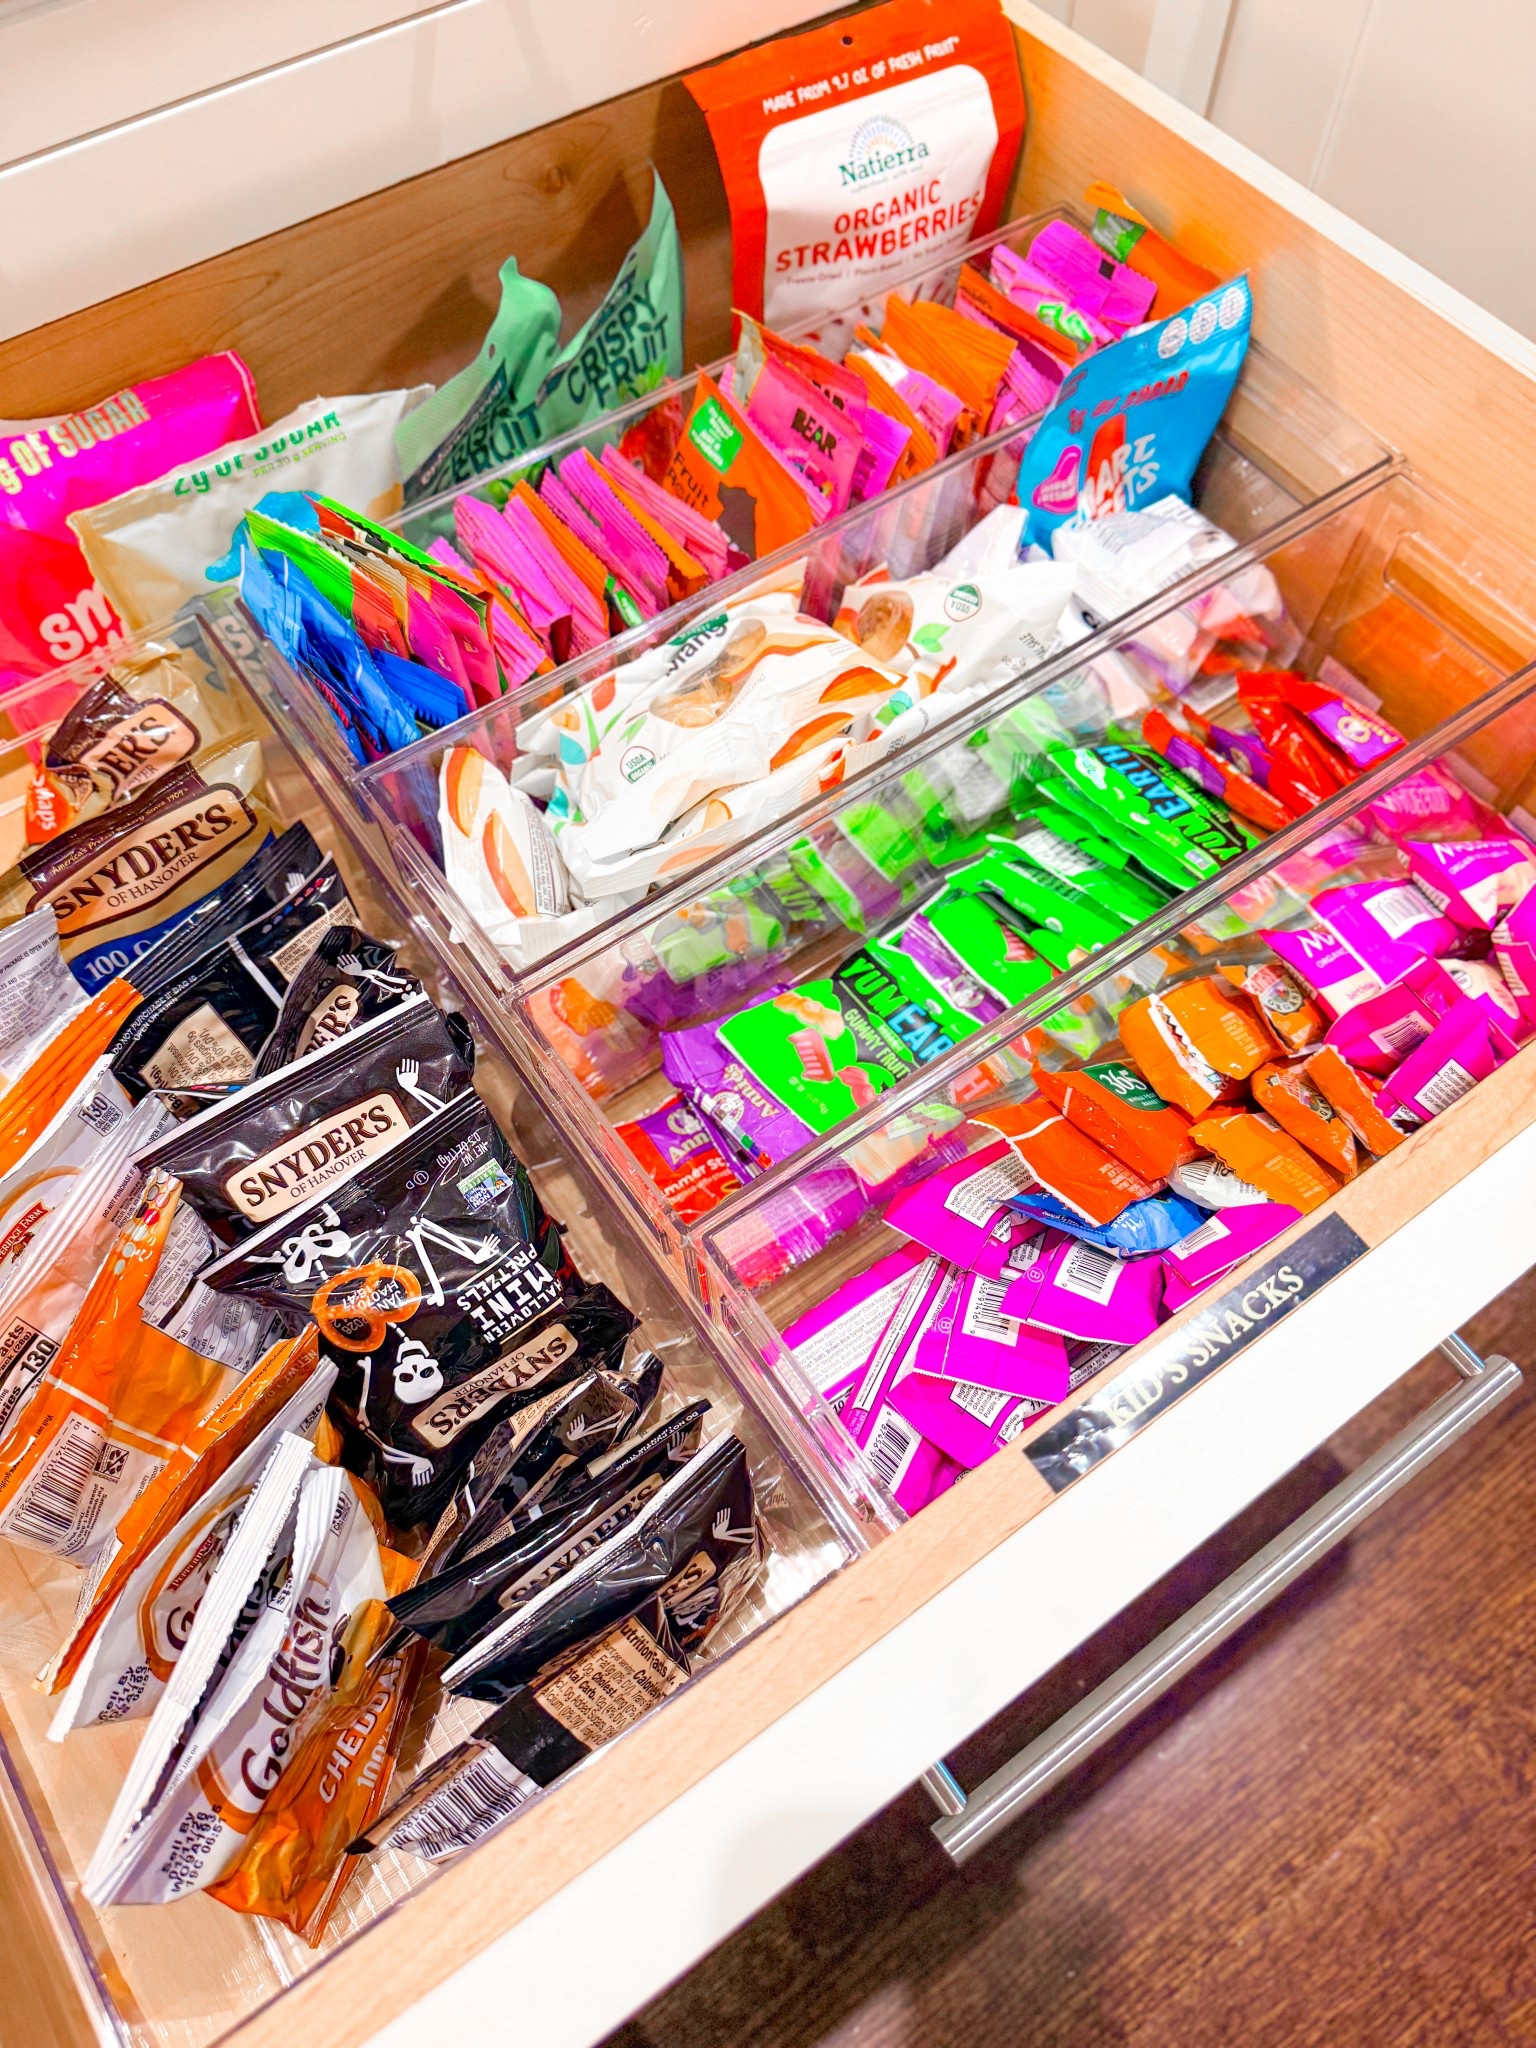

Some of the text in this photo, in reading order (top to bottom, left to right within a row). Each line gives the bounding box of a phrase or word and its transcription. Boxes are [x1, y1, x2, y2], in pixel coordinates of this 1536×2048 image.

[762, 89, 796, 114] MADE
[797, 80, 832, 105] FROM
[871, 63, 887, 79] OF
[888, 51, 923, 74] FRESH
[839, 142, 929, 187] Natierra
[834, 179, 942, 234] ORGANIC
[775, 189, 982, 273] STRAWBERRIES
[567, 279, 656, 405] CRISPY
[591, 315, 669, 409] FRUIT
[11, 390, 152, 477] OF SUGAR
[791, 407, 837, 461] BEAR
[674, 451, 709, 509] Fruit
[951, 600, 971, 614] USDA
[624, 753, 646, 771] USDA
[51, 844, 88, 877] America's
[145, 799, 167, 822] Since
[107, 852, 199, 909] OF HANOVER
[2, 953, 26, 971] PACKAGE
[23, 950, 30, 958] IS
[28, 943, 43, 955] OPEN
[41, 939, 50, 947] OR
[84, 949, 129, 981] 100
[118, 1026, 138, 1046] NOT
[844, 1007, 880, 1052] GUMMY
[876, 1043, 912, 1079] FRUIT
[1099, 1069, 1148, 1096] 365
[78, 1093, 112, 1126] 130
[91, 1104, 119, 1129] CALORIES
[99, 1110, 123, 1134] PER PACK
[434, 1131, 482, 1169] 0.5 OZ (14g)
[459, 1141, 489, 1167] NET WT
[101, 1167, 136, 1219] DO NOT PURCHASE IF
[291, 1148, 368, 1199] OF HANOVER
[461, 1164, 499, 1193] VERIFIED
[467, 1187, 488, 1204] GMO
[472, 1192, 491, 1208] NON
[18, 1205, 43, 1230] FARM
[171, 1221, 187, 1239] 2.1mg
[176, 1230, 194, 1252] 0.14mg
[172, 1275, 189, 1297] Calcium
[452, 1242, 542, 1313] PRETZELS
[467, 1259, 556, 1333] MINI
[176, 1302, 205, 1342] Sugars 0%
[481, 1279, 565, 1344] HALLOWEEN
[11, 1329, 34, 1355] (28g)
[17, 1336, 58, 1379] 130
[297, 1347, 319, 1370] NET
[1101, 1358, 1189, 1429] KID'S
[1187, 1265, 1305, 1367] SNACKS
[428, 1336, 568, 1436] SNYDER'S
[454, 1352, 526, 1398] OF HANOVER
[667, 1410, 699, 1434] DO NOT
[597, 1653, 612, 1668] Fat
[240, 1594, 329, 1801] Goldfish
[540, 1685, 567, 1711] alcium
[564, 1666, 583, 1685] otal
[577, 1678, 601, 1701] Carb.
[592, 1695, 609, 1712] 12g
[590, 1670, 620, 1699] Cholest.
[631, 1667, 664, 1699] Calories
[561, 1687, 610, 1732] 0g Added Sugars,
[160, 1810, 197, 1875] Sell By
